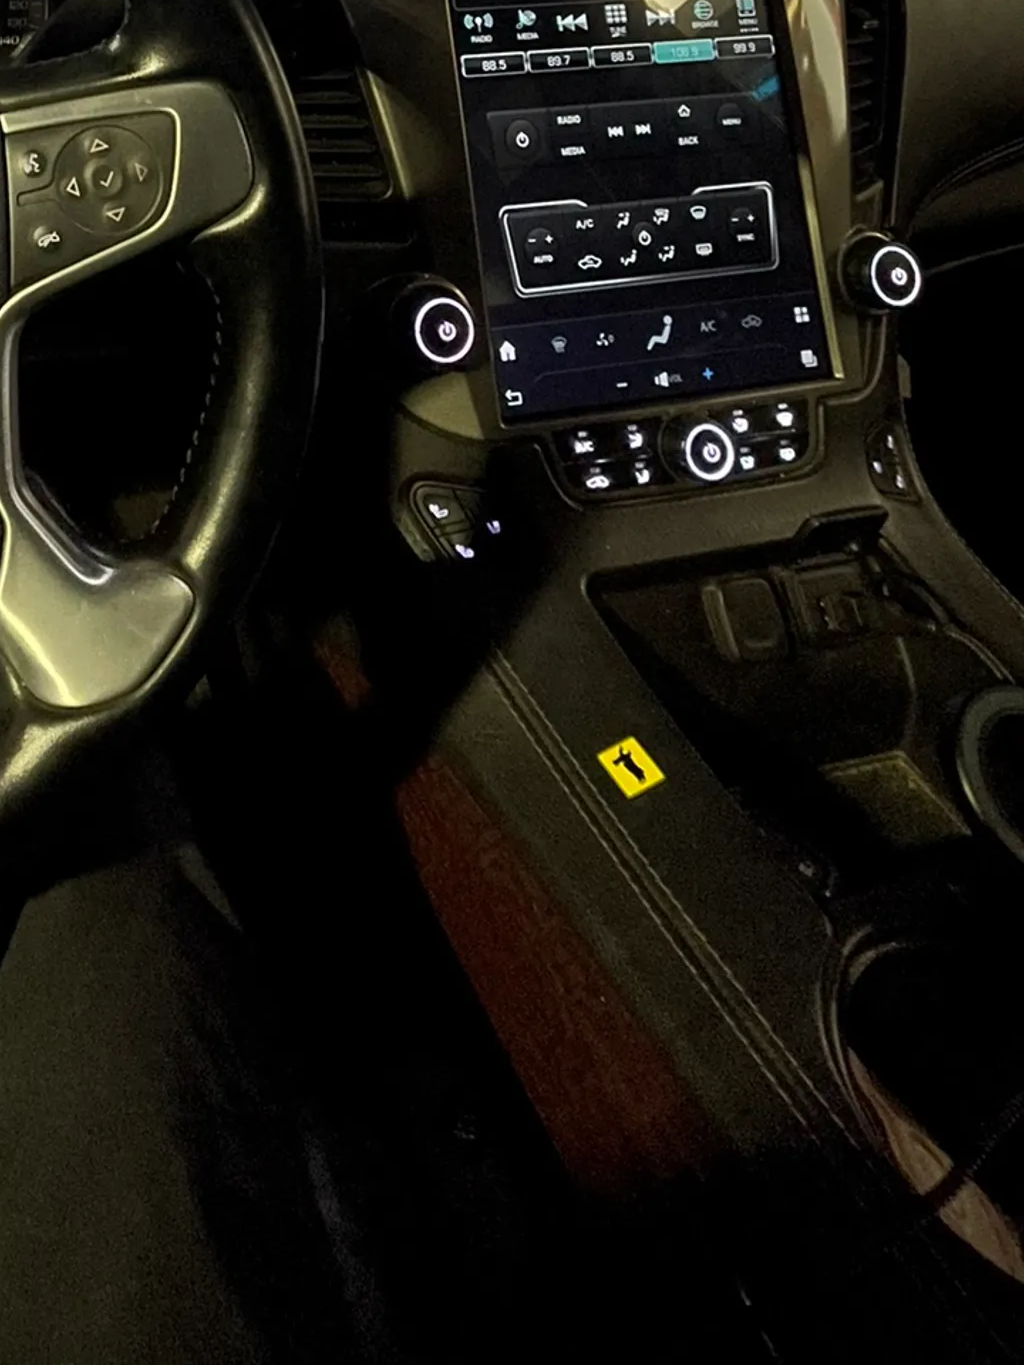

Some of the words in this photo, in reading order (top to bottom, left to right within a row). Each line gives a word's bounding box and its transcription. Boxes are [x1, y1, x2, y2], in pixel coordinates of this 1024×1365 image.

[547, 55, 570, 67] 89.7
[610, 50, 635, 62] 88.5
[481, 59, 507, 72] 88.5
[557, 114, 582, 125] RADIO
[678, 135, 699, 146] BACK
[561, 145, 586, 156] MEDIA
[576, 218, 595, 230] A/C
